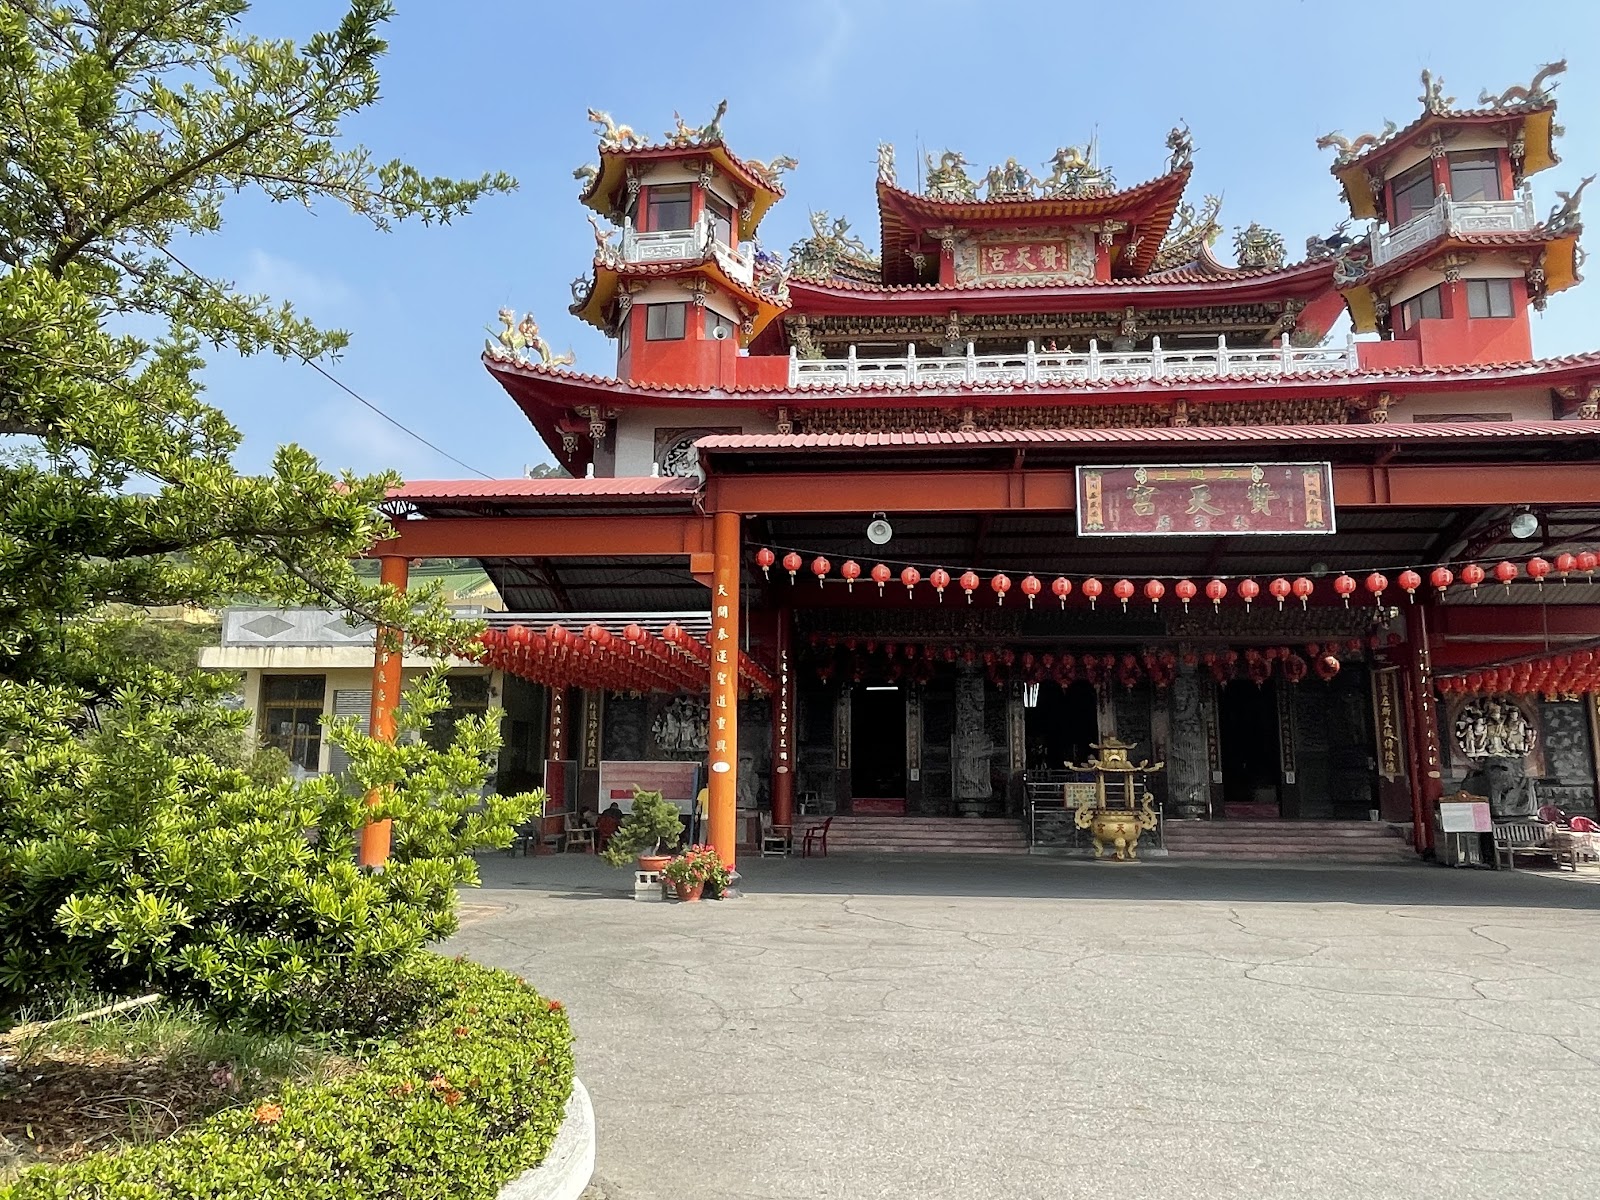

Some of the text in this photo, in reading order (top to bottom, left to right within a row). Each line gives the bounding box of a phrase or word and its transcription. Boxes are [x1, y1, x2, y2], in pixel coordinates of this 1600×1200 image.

[988, 245, 1061, 271] 贊天宮
[1156, 469, 1240, 481] 五恩主
[1126, 483, 1280, 517] 贊天宮
[715, 584, 730, 753] 天開泰運聖道重興
